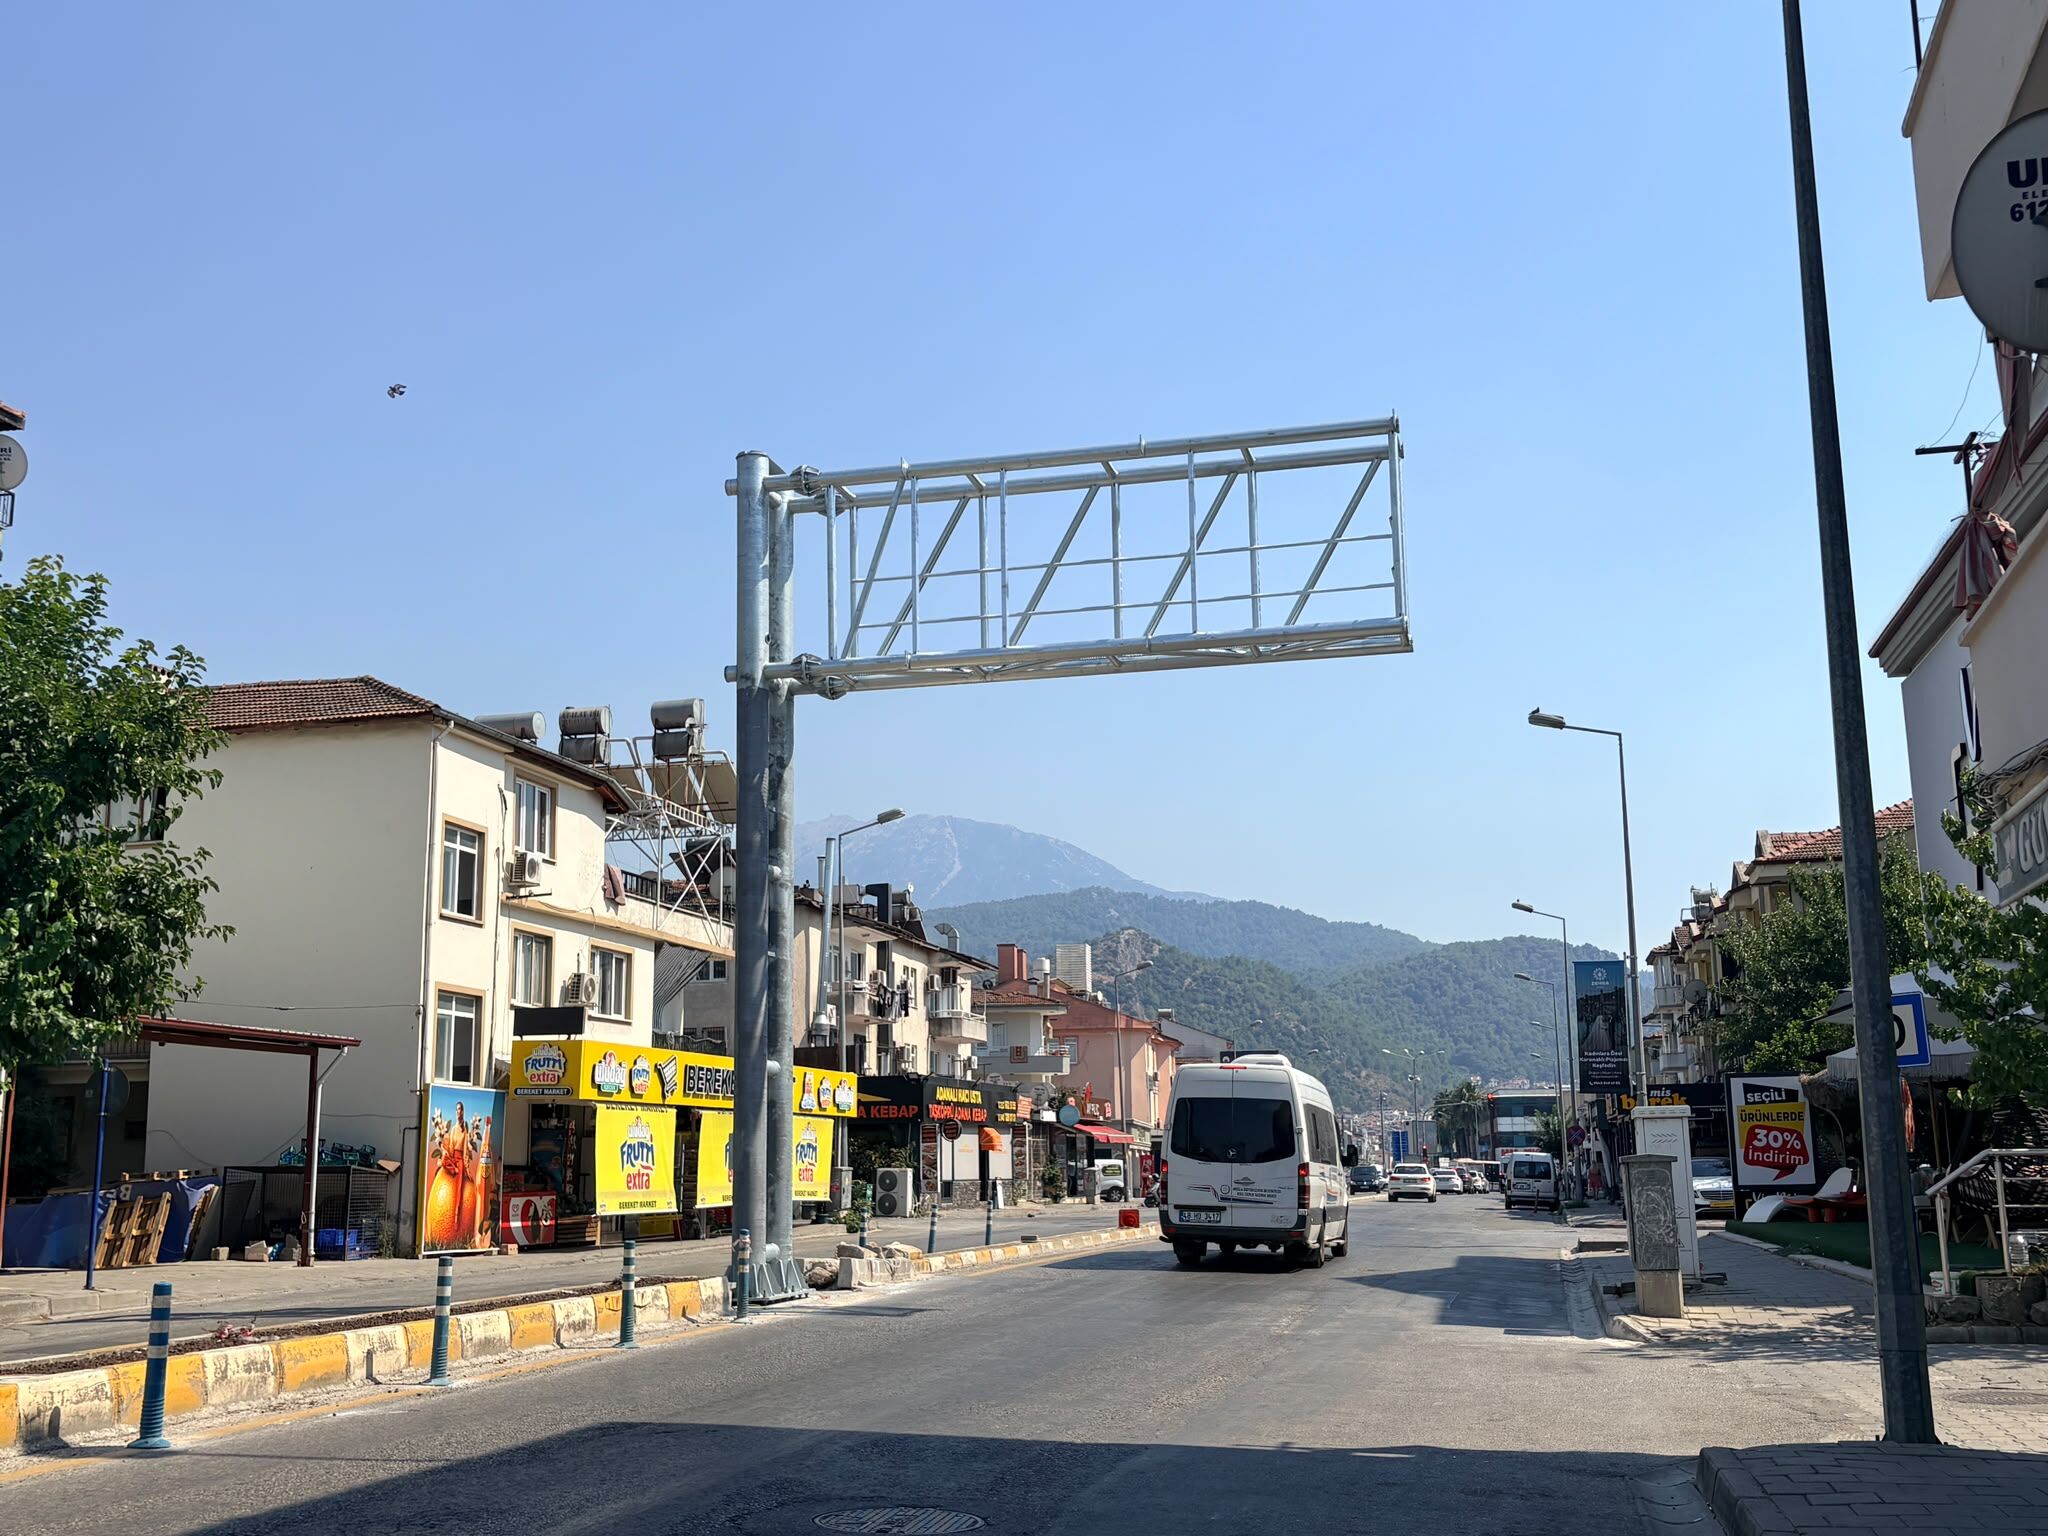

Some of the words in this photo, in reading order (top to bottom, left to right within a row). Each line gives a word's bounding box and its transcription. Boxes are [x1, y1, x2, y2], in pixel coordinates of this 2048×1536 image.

[529, 1071, 557, 1083] extra
[1650, 1087, 1671, 1097] mis
[1746, 1088, 1786, 1104] SEÇİLİ
[1620, 1093, 1687, 1110] brek
[870, 1105, 918, 1118] KEBAP
[1740, 1109, 1805, 1122] ÜRÜNLERDE
[1752, 1129, 1802, 1149] 30%
[626, 1169, 651, 1190] extra
[798, 1165, 814, 1183] extra
